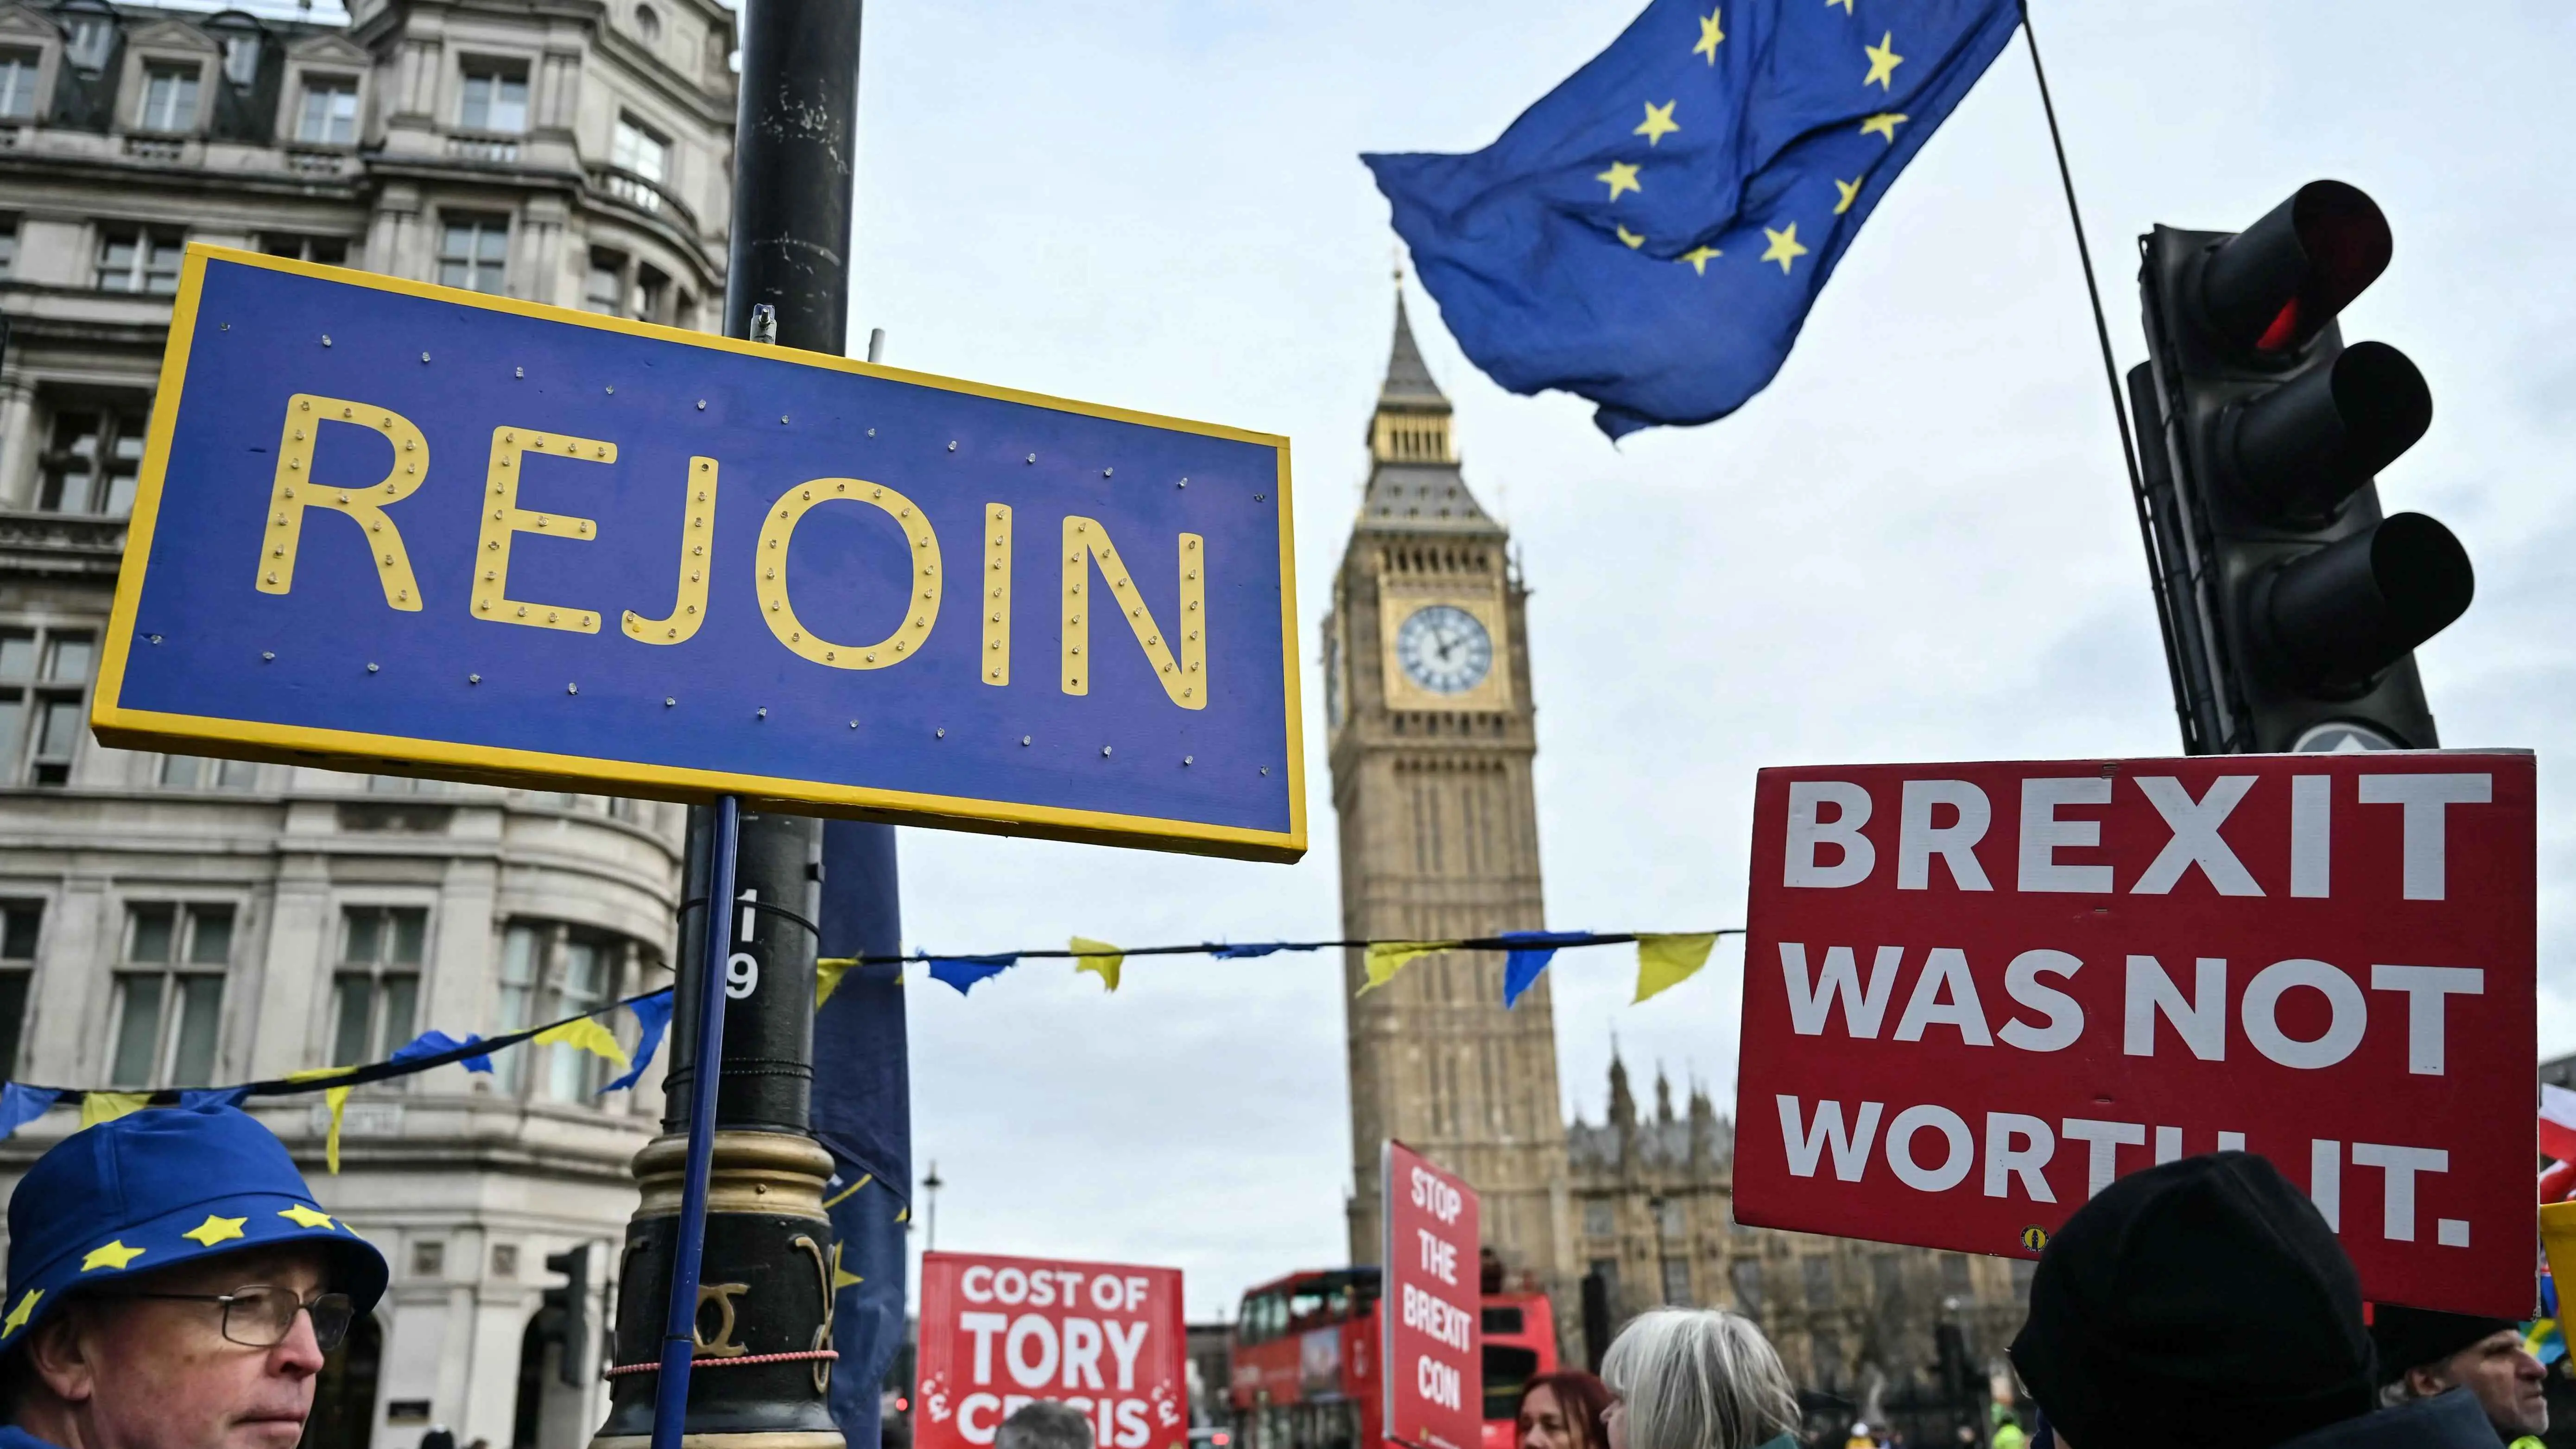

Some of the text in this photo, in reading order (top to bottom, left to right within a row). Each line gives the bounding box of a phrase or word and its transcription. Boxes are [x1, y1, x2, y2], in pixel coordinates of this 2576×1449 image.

[255, 394, 1207, 709] REJOIN
[1784, 773, 2492, 900] BREXIT
[1779, 943, 2484, 1076] WAS NOT
[1411, 1166, 1462, 1226] STOP
[1776, 1095, 2469, 1247] WORT IT.
[961, 1265, 1150, 1312] COST OF
[1417, 1228, 1457, 1286] THE
[960, 1311, 1149, 1391] TORY
[1403, 1282, 1472, 1353] BREXIT
[1418, 1354, 1461, 1411] CON
